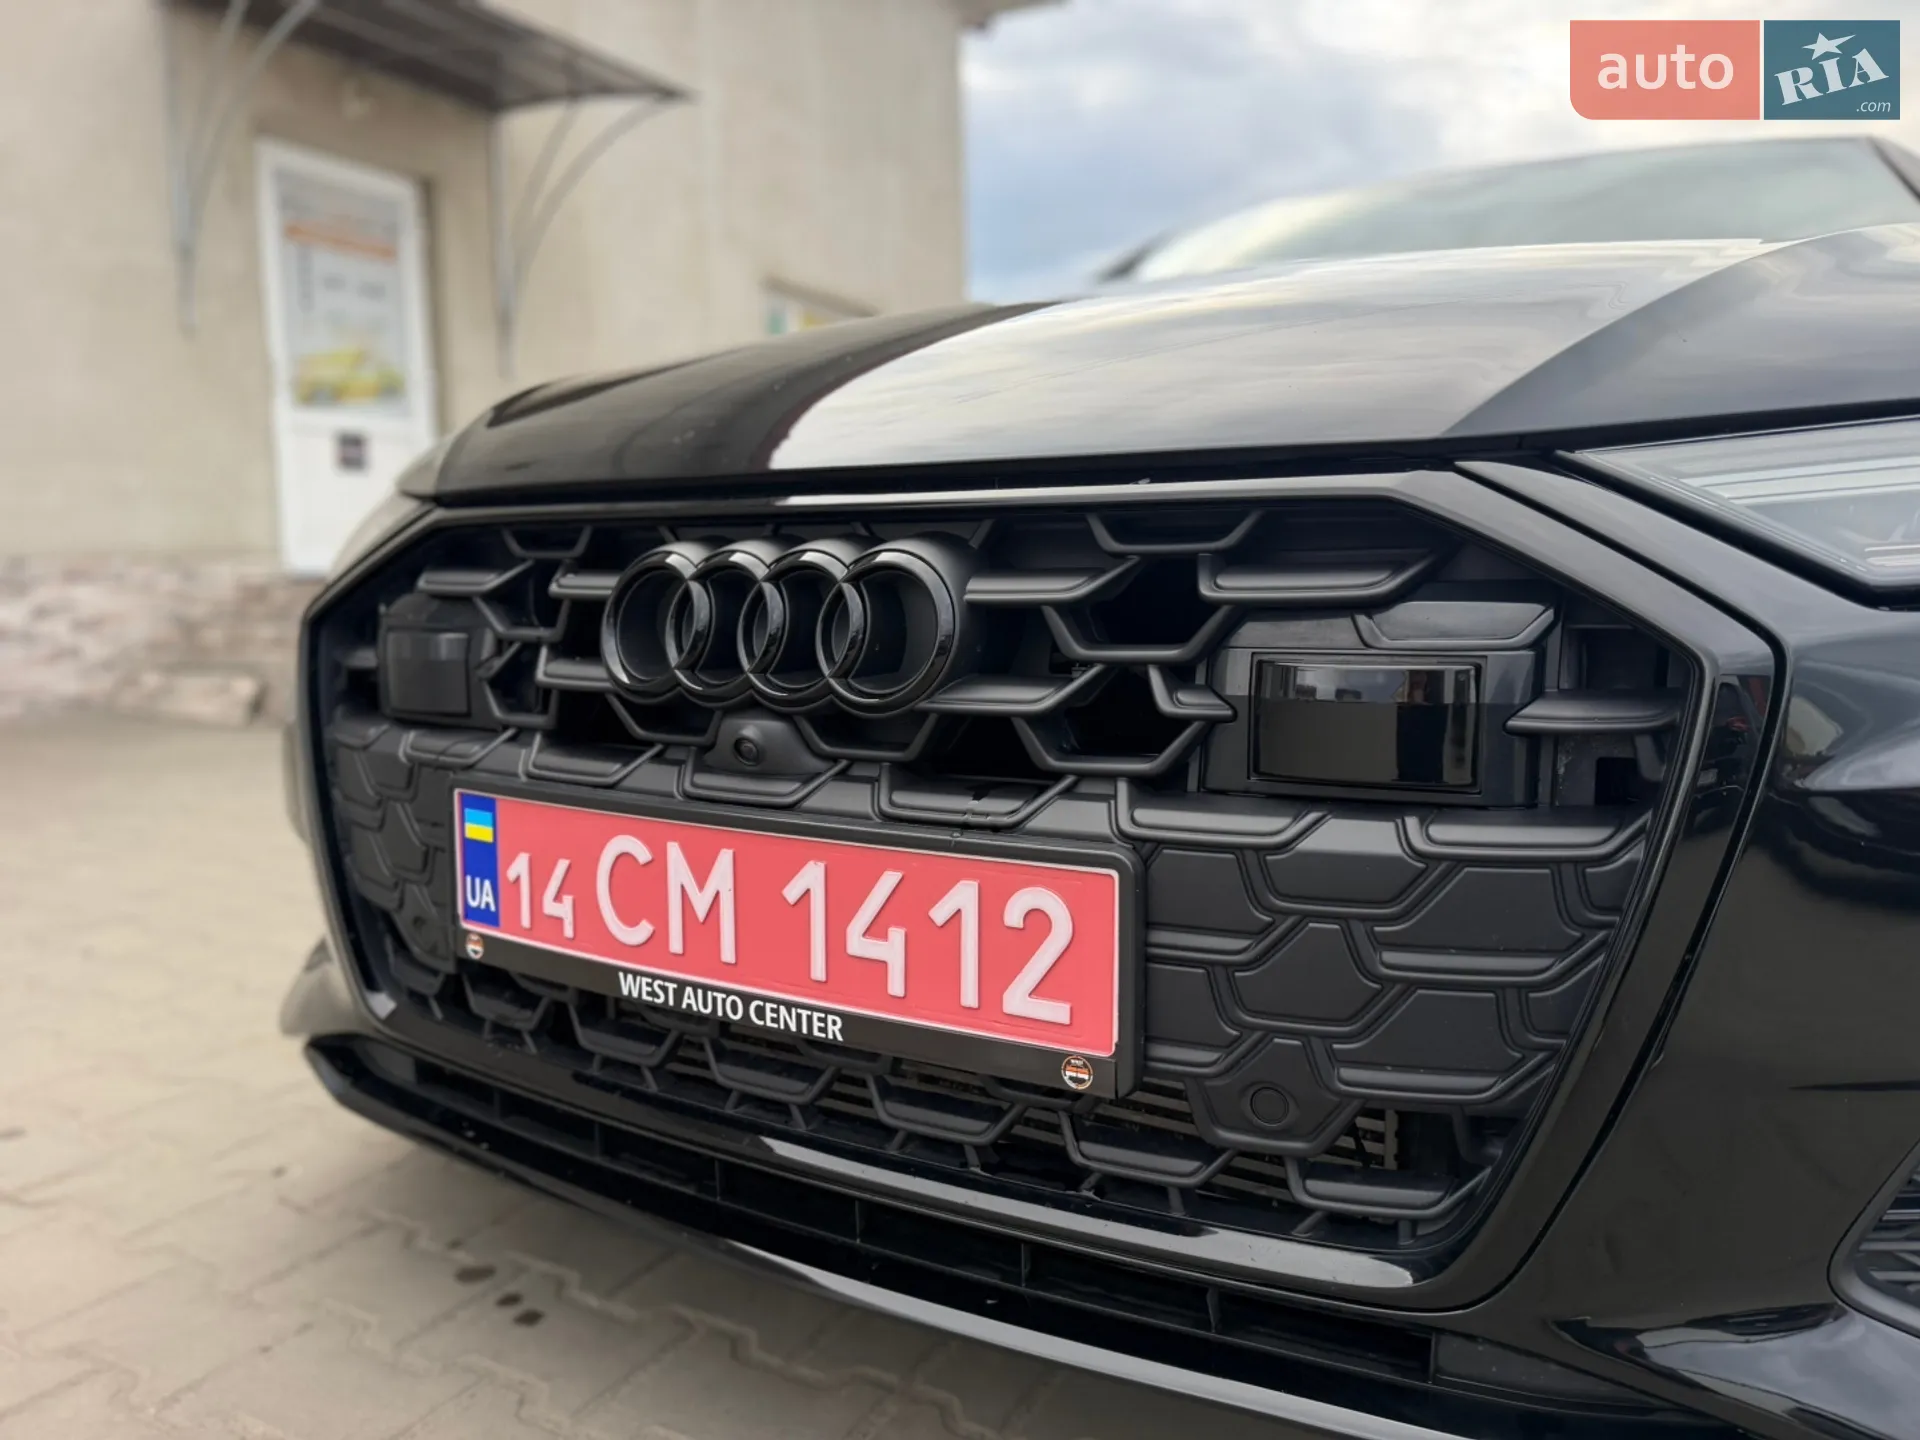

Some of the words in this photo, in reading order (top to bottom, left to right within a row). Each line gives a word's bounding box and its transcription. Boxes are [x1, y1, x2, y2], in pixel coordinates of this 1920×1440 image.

[465, 875, 497, 912] UA
[507, 852, 574, 939] 14
[596, 834, 736, 964] CM
[781, 861, 1073, 1025] 1412
[618, 971, 678, 1005] WEST
[682, 986, 744, 1021] AUTO
[749, 1000, 843, 1042] CENTER
